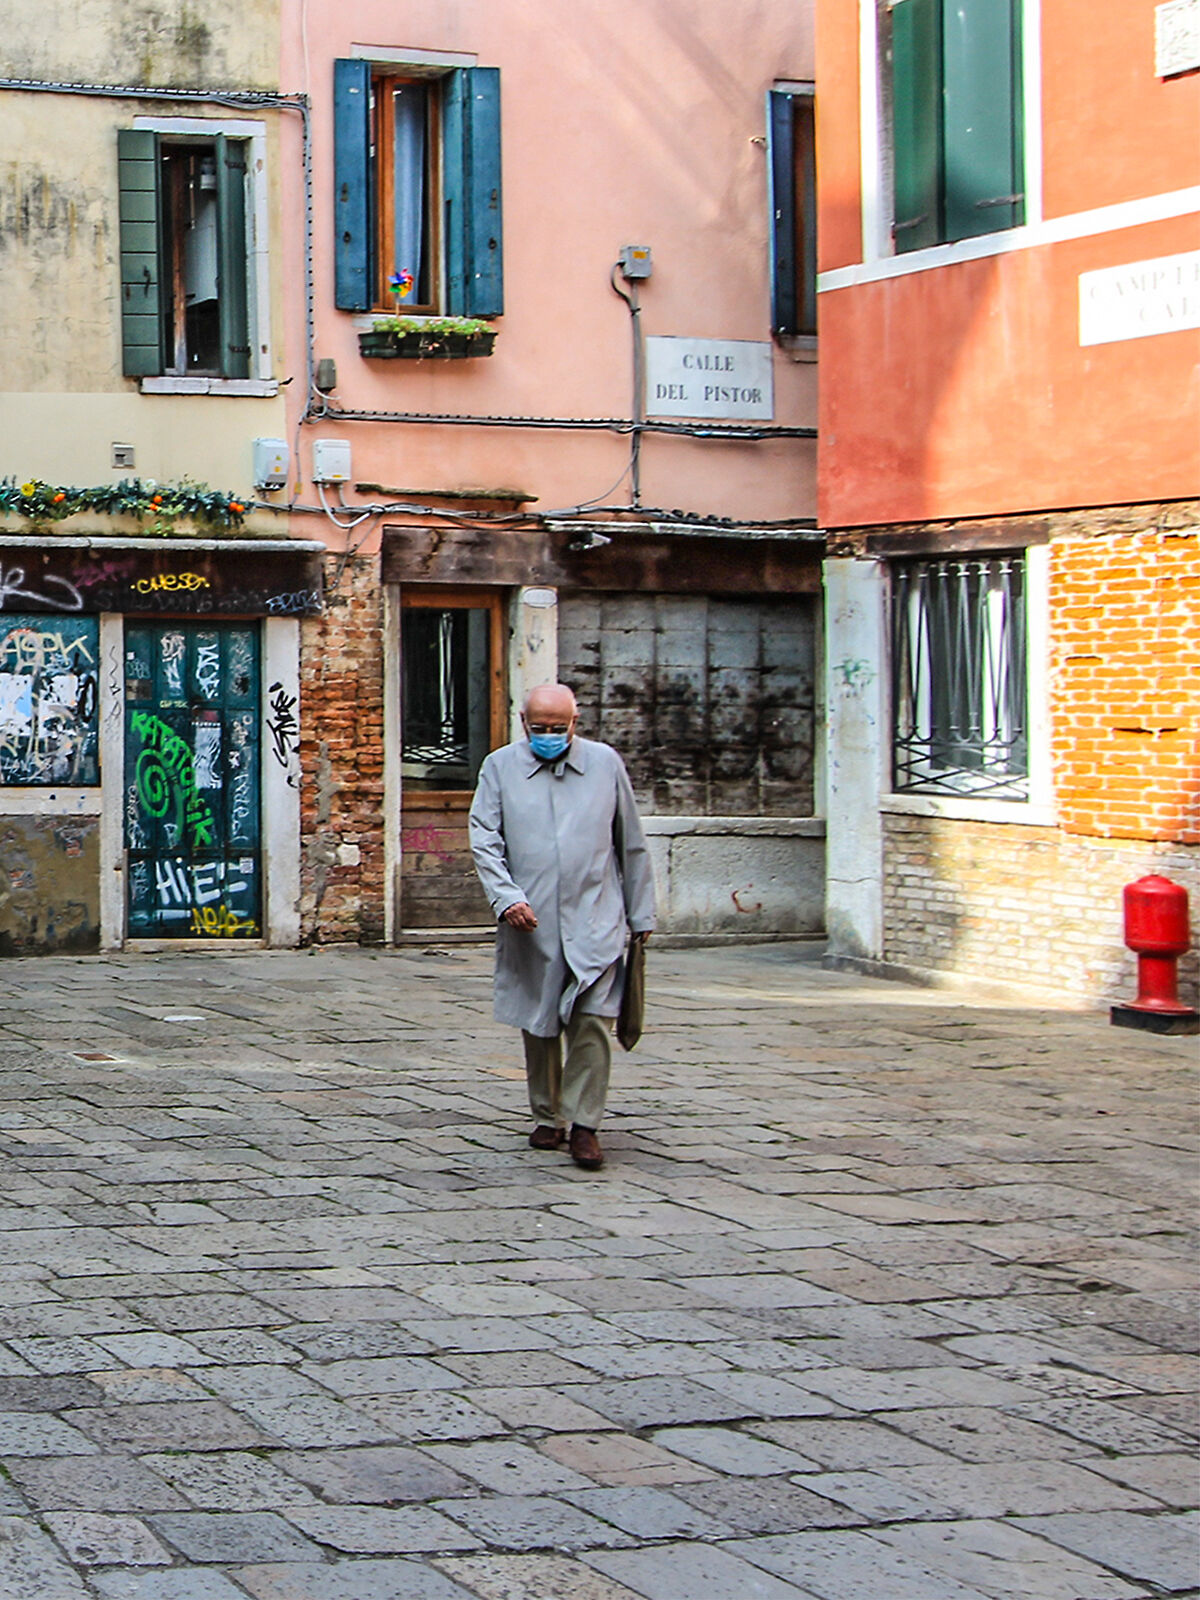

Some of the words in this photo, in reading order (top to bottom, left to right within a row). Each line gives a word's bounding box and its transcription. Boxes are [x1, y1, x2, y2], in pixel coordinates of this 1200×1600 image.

[682, 354, 735, 372] CALLE
[656, 384, 688, 401] DEL
[704, 385, 762, 404] PISTOR
